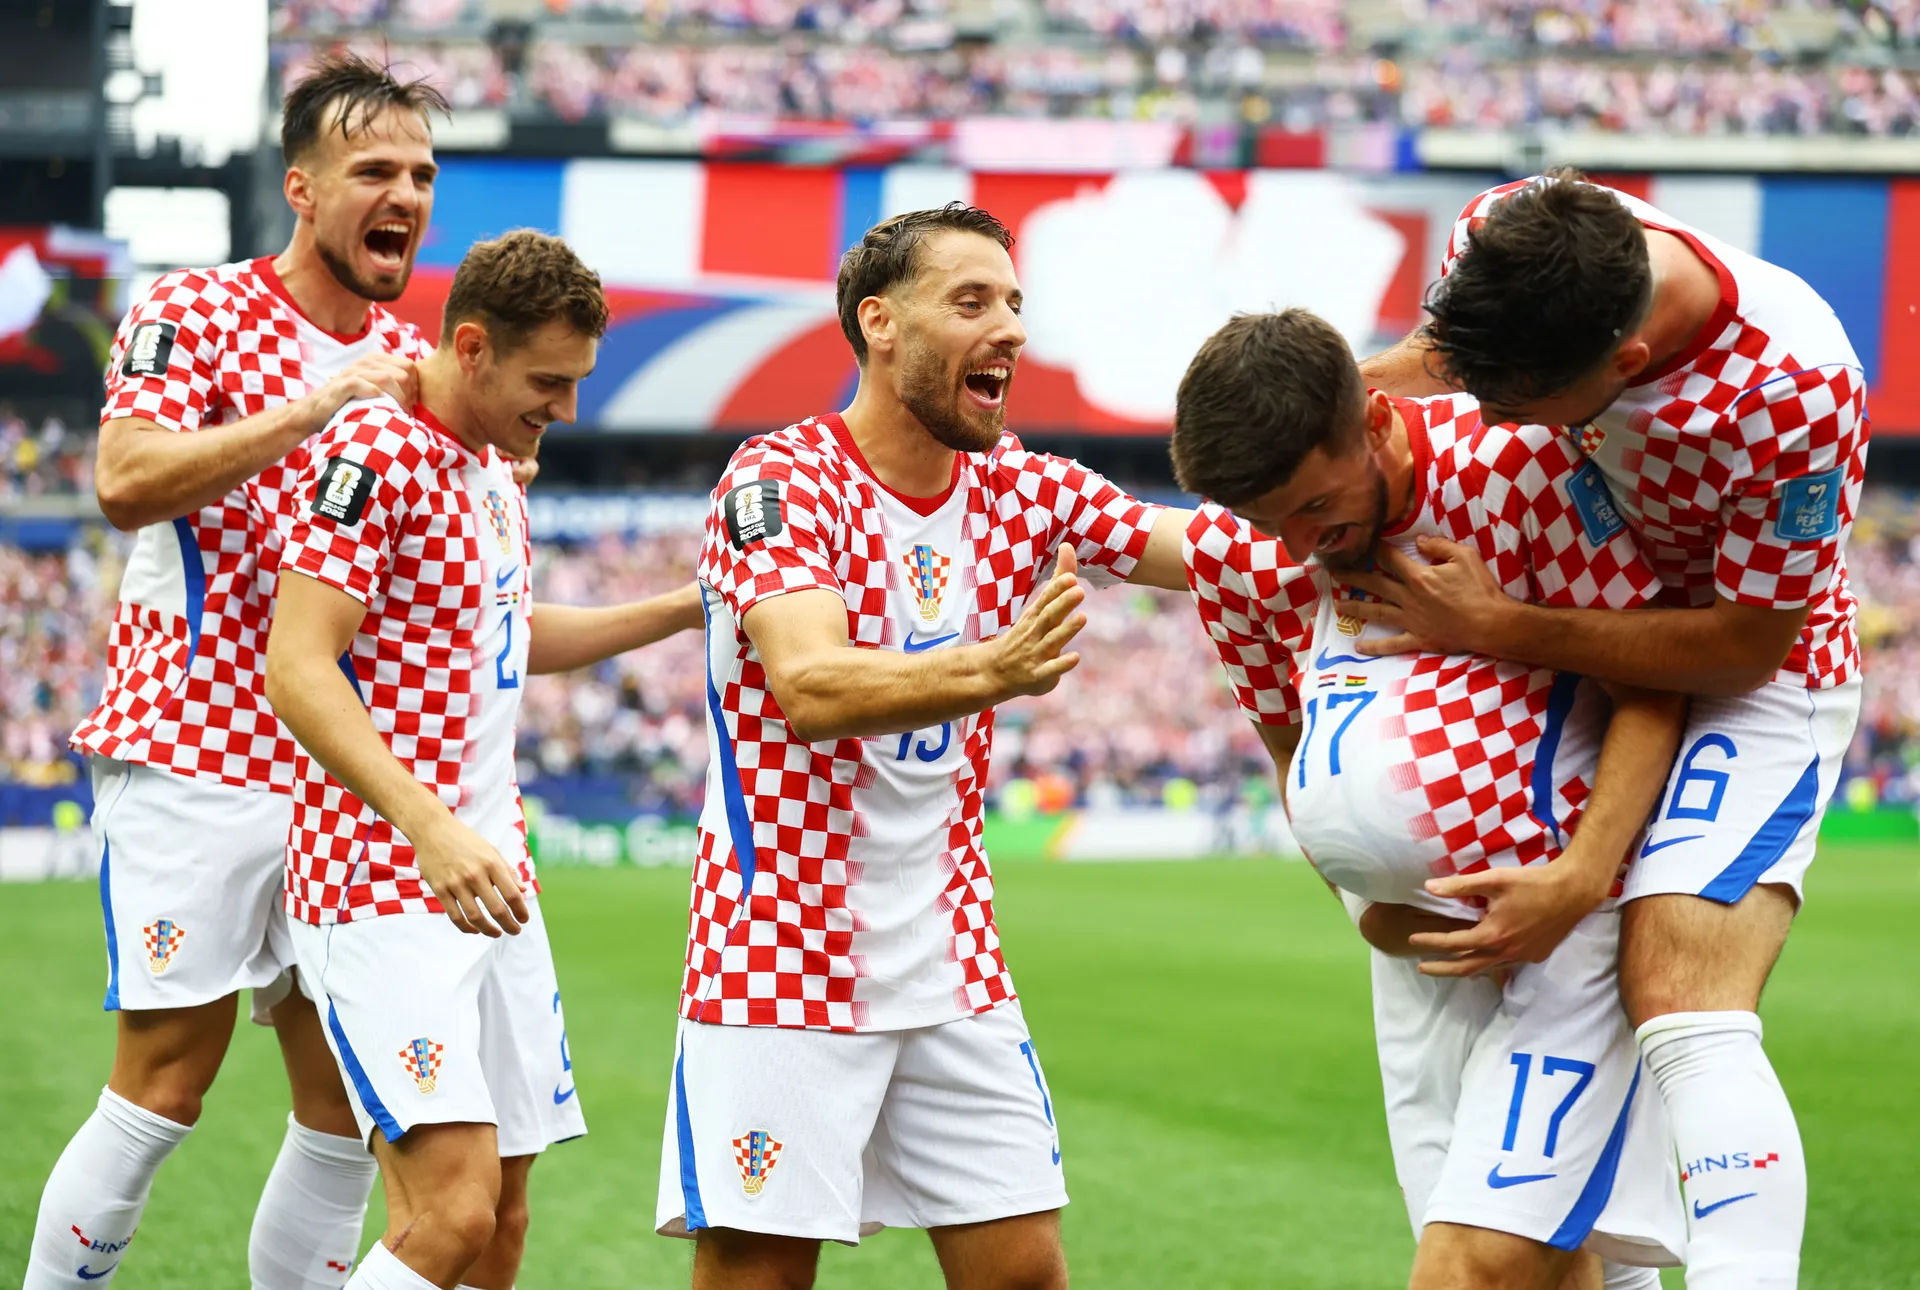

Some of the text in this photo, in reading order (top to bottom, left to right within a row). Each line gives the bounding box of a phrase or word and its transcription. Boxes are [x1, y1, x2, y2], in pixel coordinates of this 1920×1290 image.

[739, 526, 767, 541] 2026
[919, 550, 931, 591] HNS
[496, 609, 519, 690] 2
[1298, 690, 1379, 790] 17
[1501, 1052, 1596, 1159] 17
[752, 1135, 763, 1170] HNS
[1687, 1152, 1750, 1177] HNS
